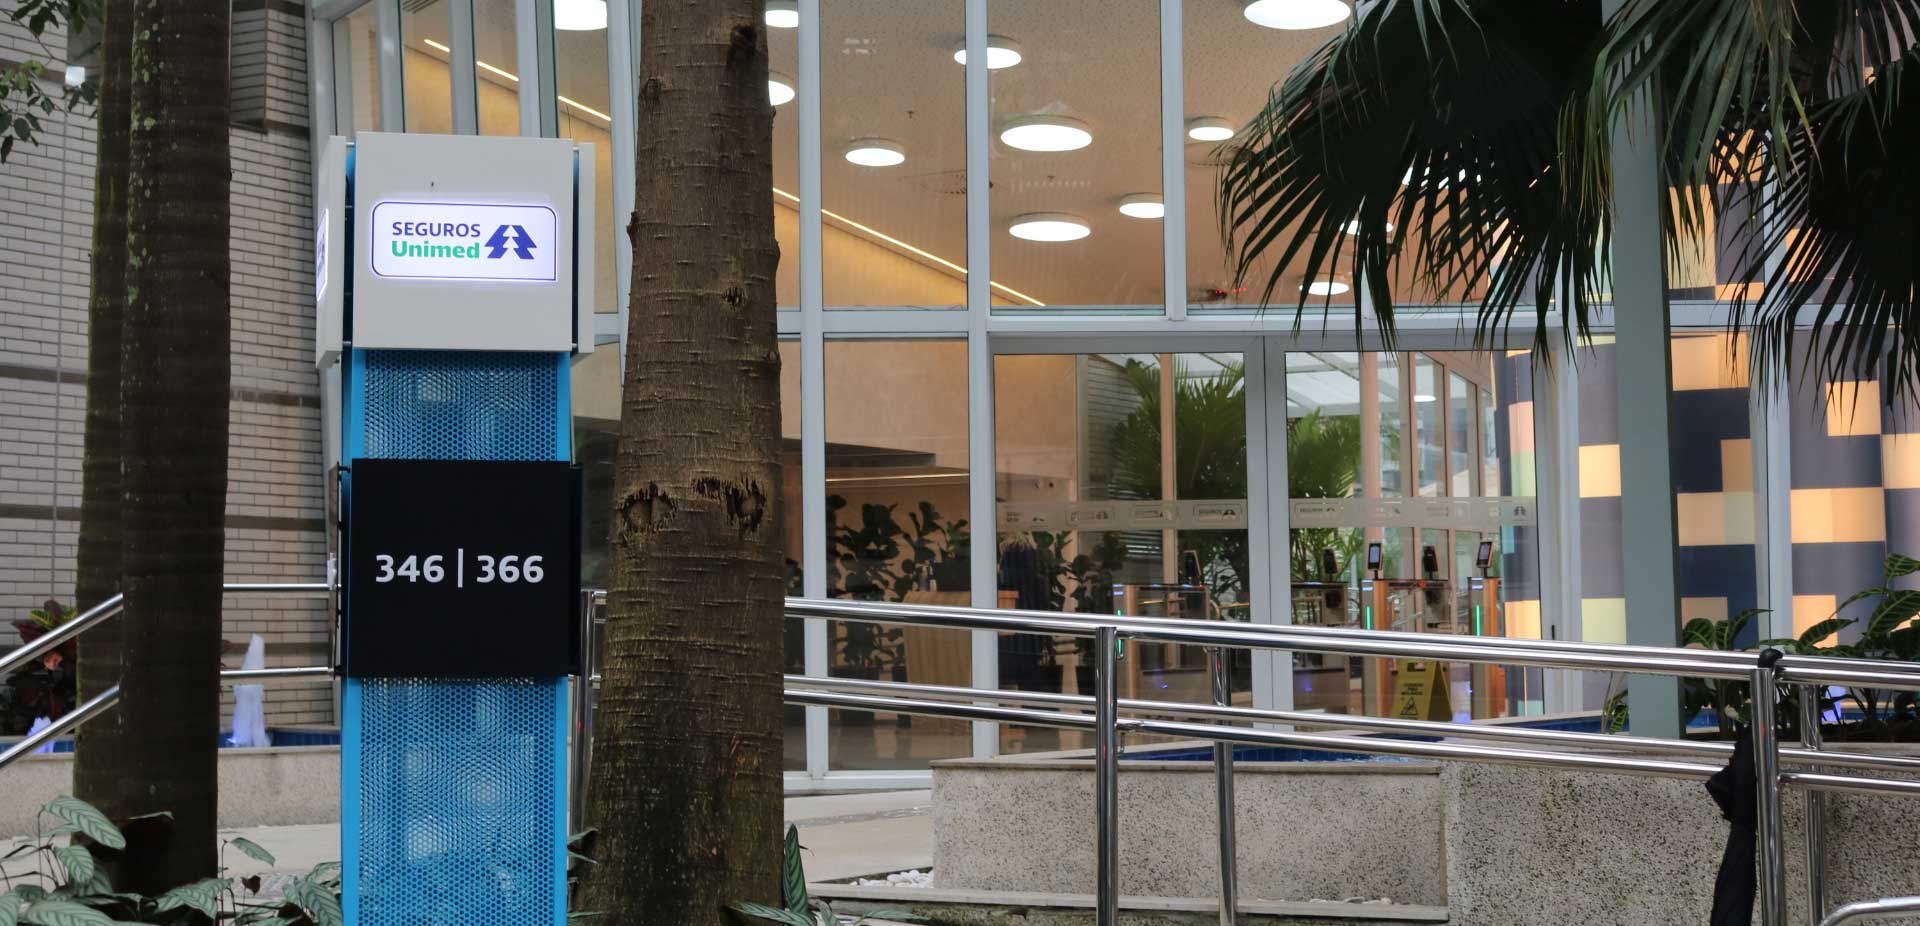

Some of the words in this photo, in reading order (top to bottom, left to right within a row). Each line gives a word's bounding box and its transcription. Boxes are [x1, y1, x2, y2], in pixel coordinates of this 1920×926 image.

[392, 221, 481, 238] SEGUROS
[391, 240, 480, 259] Unimed
[375, 554, 445, 583] 346
[476, 554, 545, 583] 366
